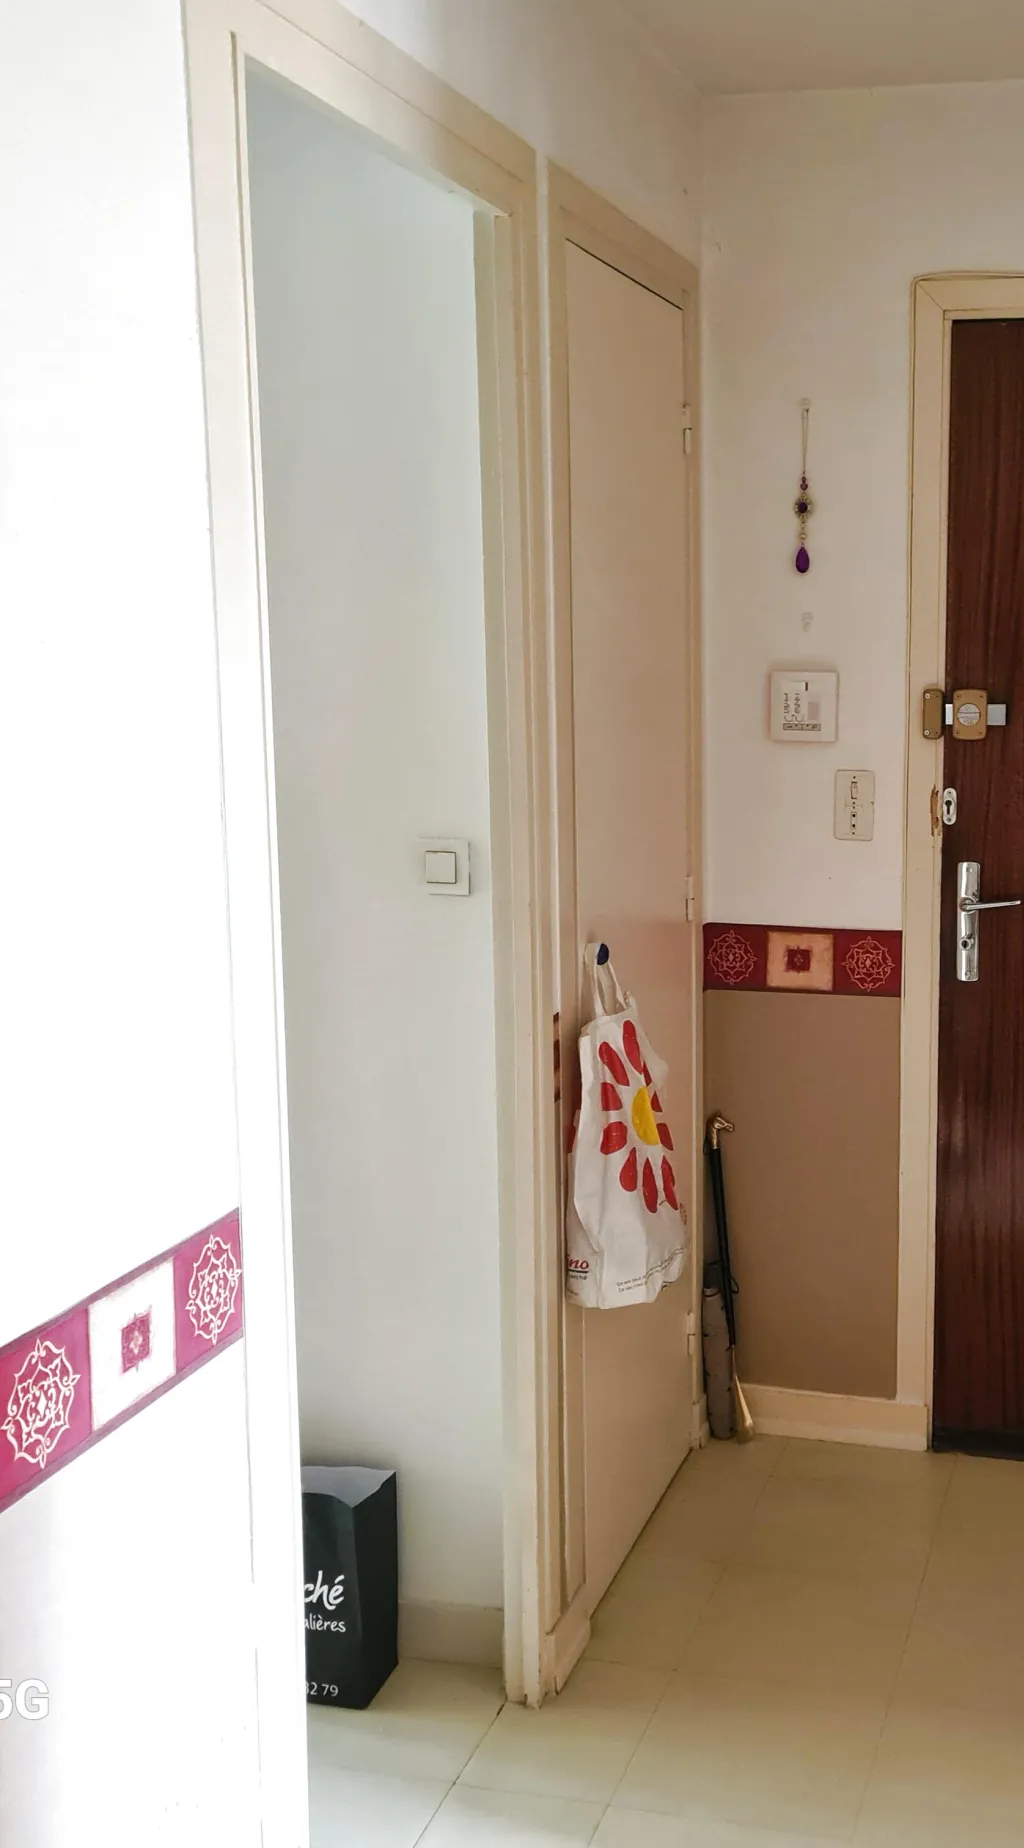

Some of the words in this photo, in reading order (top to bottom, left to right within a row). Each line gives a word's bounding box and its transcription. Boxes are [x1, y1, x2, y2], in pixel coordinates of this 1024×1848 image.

[569, 1258, 589, 1270] no
[304, 1570, 345, 1610] ché
[305, 1613, 346, 1632] alières
[321, 1683, 339, 1697] 79
